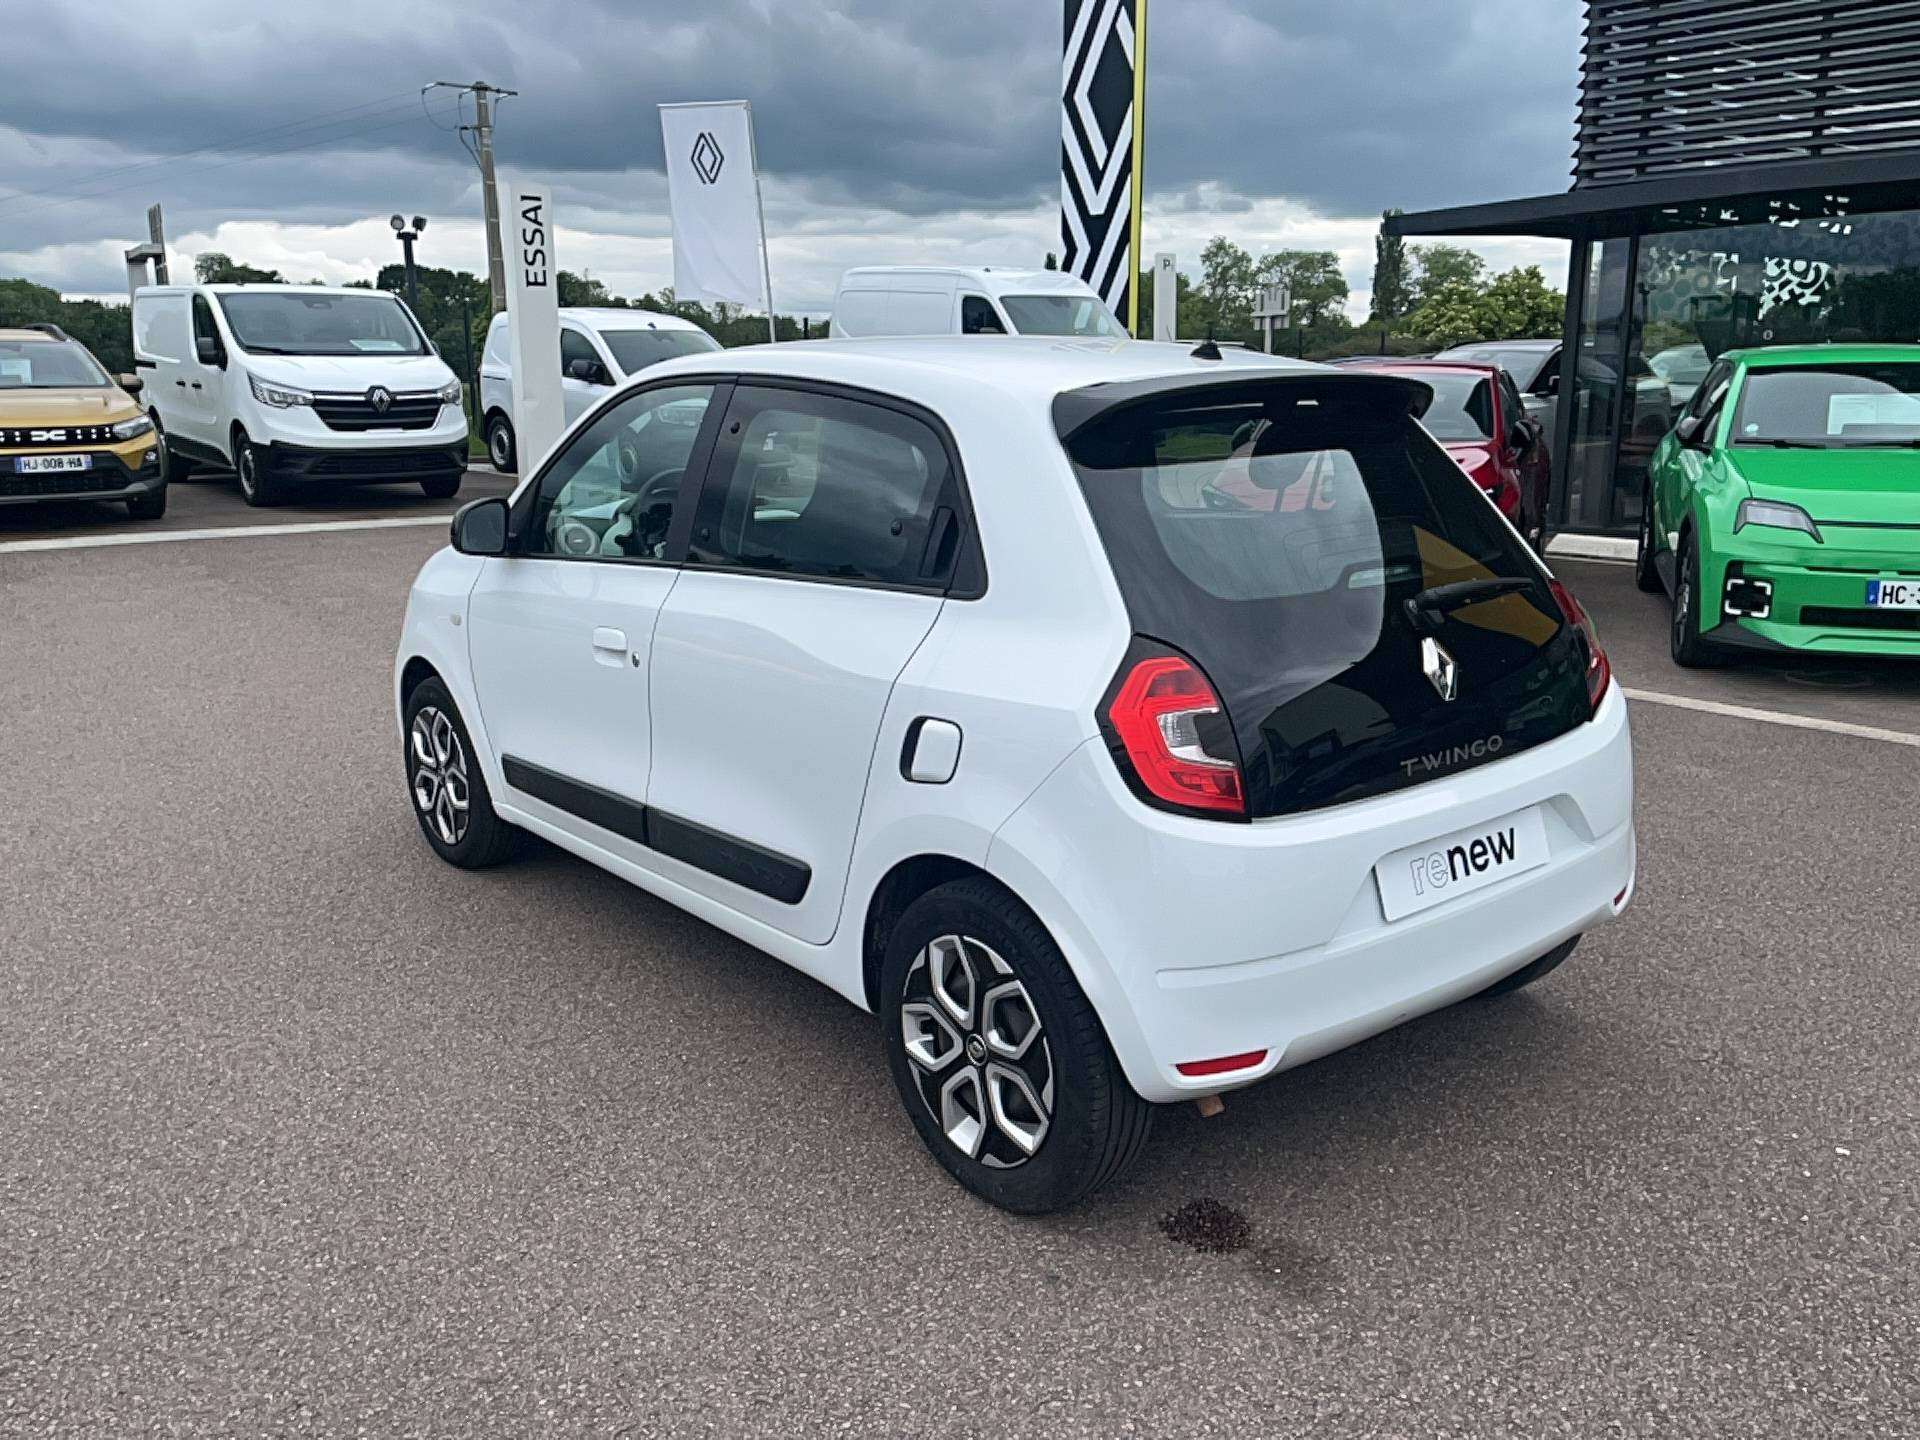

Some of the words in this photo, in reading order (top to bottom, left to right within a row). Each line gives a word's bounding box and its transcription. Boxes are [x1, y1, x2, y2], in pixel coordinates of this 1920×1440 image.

[520, 194, 547, 287] ESSAI
[1163, 259, 1171, 271] P
[1881, 585, 1920, 605] HC-
[1400, 735, 1503, 777] TWINGO
[1410, 827, 1515, 896] renew
